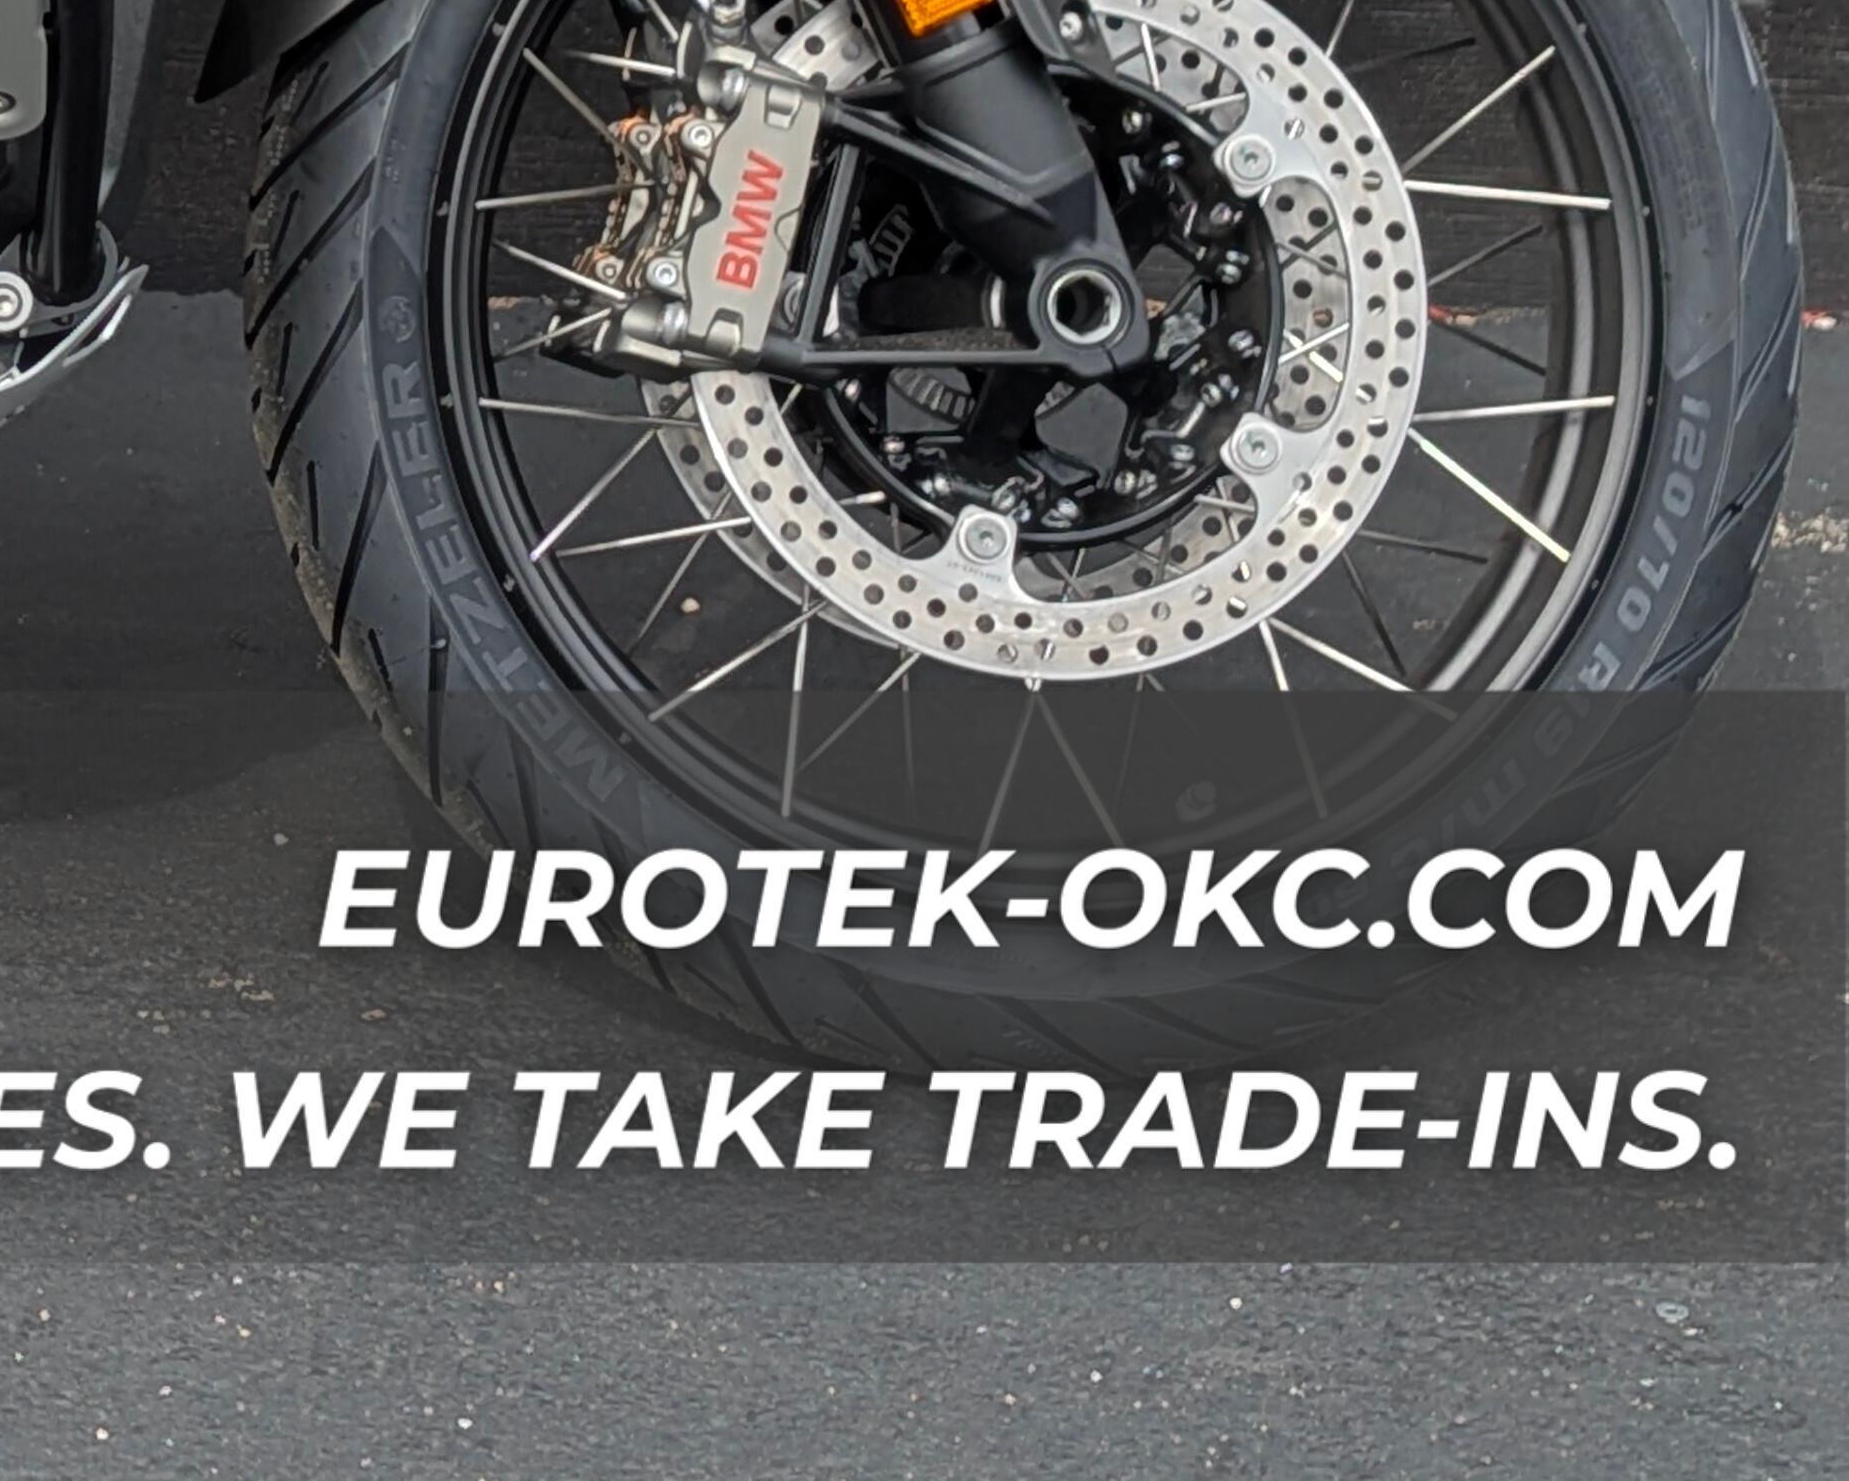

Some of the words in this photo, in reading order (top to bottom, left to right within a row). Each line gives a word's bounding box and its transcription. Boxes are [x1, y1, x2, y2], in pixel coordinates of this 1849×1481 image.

[715, 151, 784, 289] BMW
[382, 359, 626, 804] METZELER
[1616, 393, 1711, 634] 120/70
